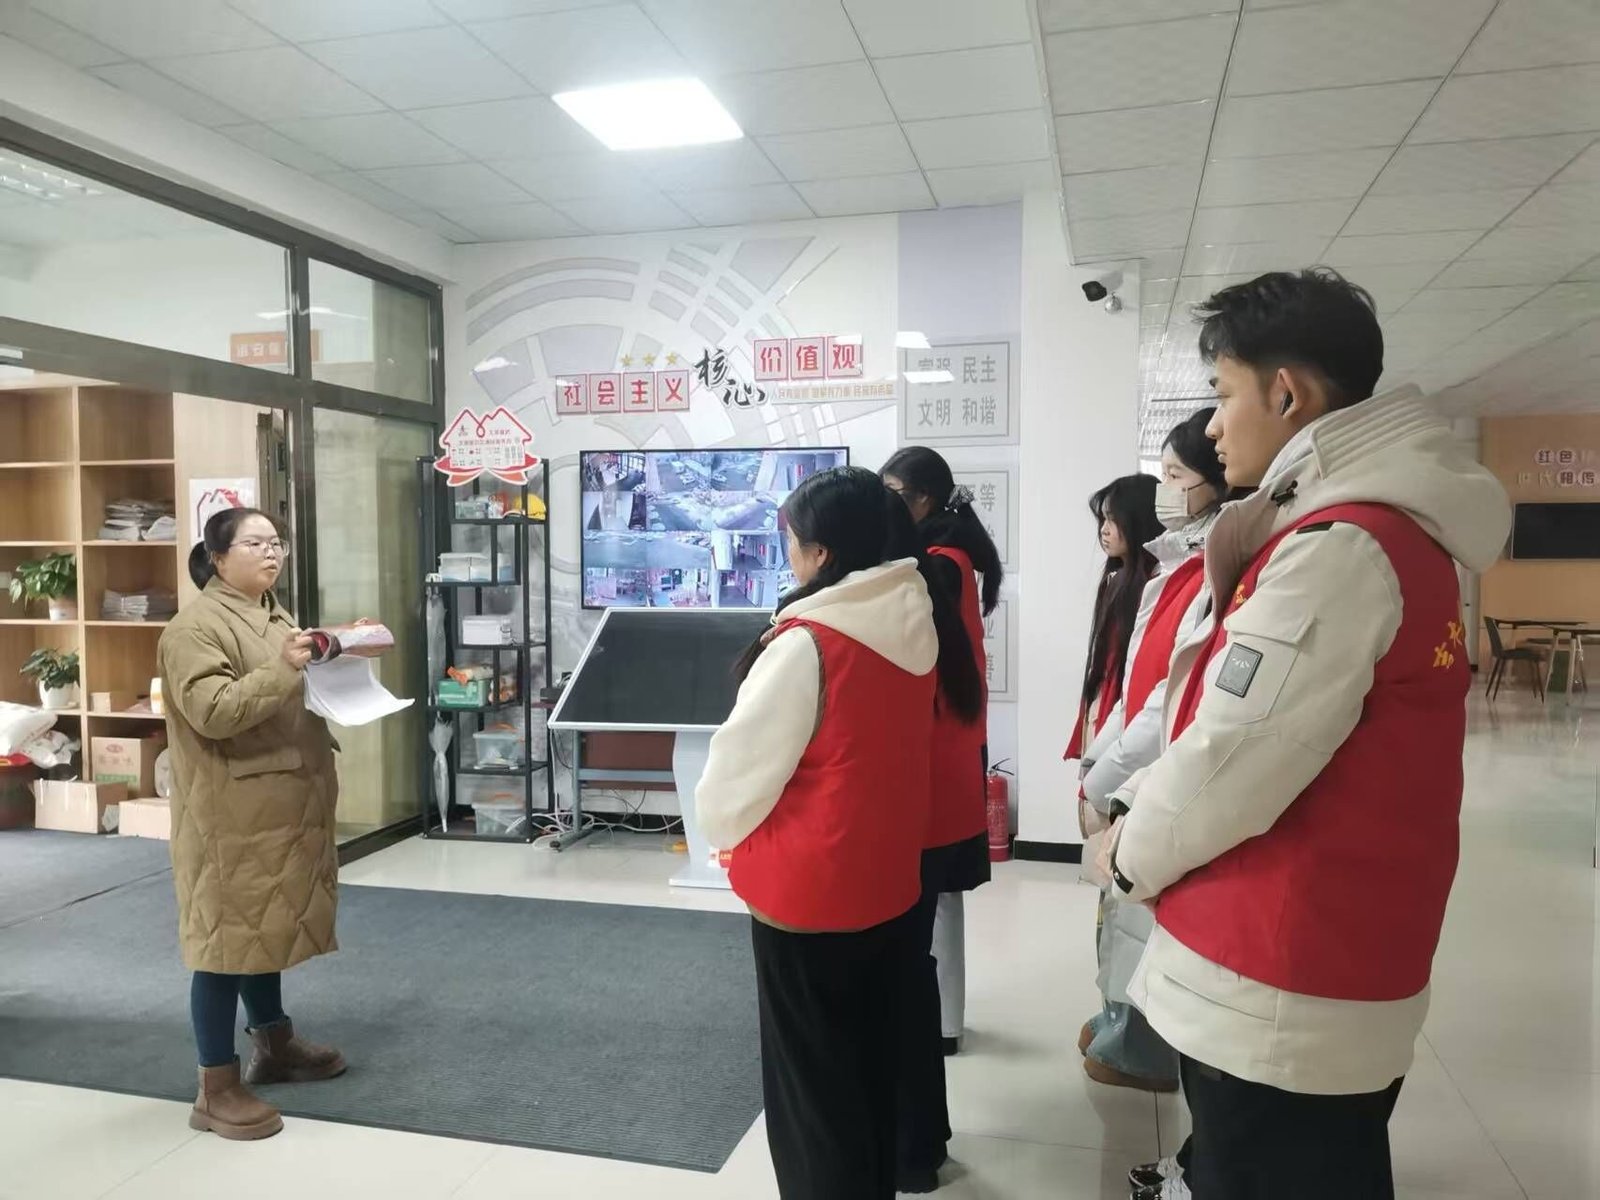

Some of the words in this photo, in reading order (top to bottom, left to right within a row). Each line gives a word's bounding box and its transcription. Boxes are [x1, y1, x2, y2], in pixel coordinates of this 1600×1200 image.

[564, 378, 684, 406] 社会主义
[695, 348, 766, 406] 核心
[760, 344, 856, 373] 价值观
[963, 355, 997, 384] 民主
[918, 398, 951, 426] 文明
[962, 395, 997, 427] 和谐
